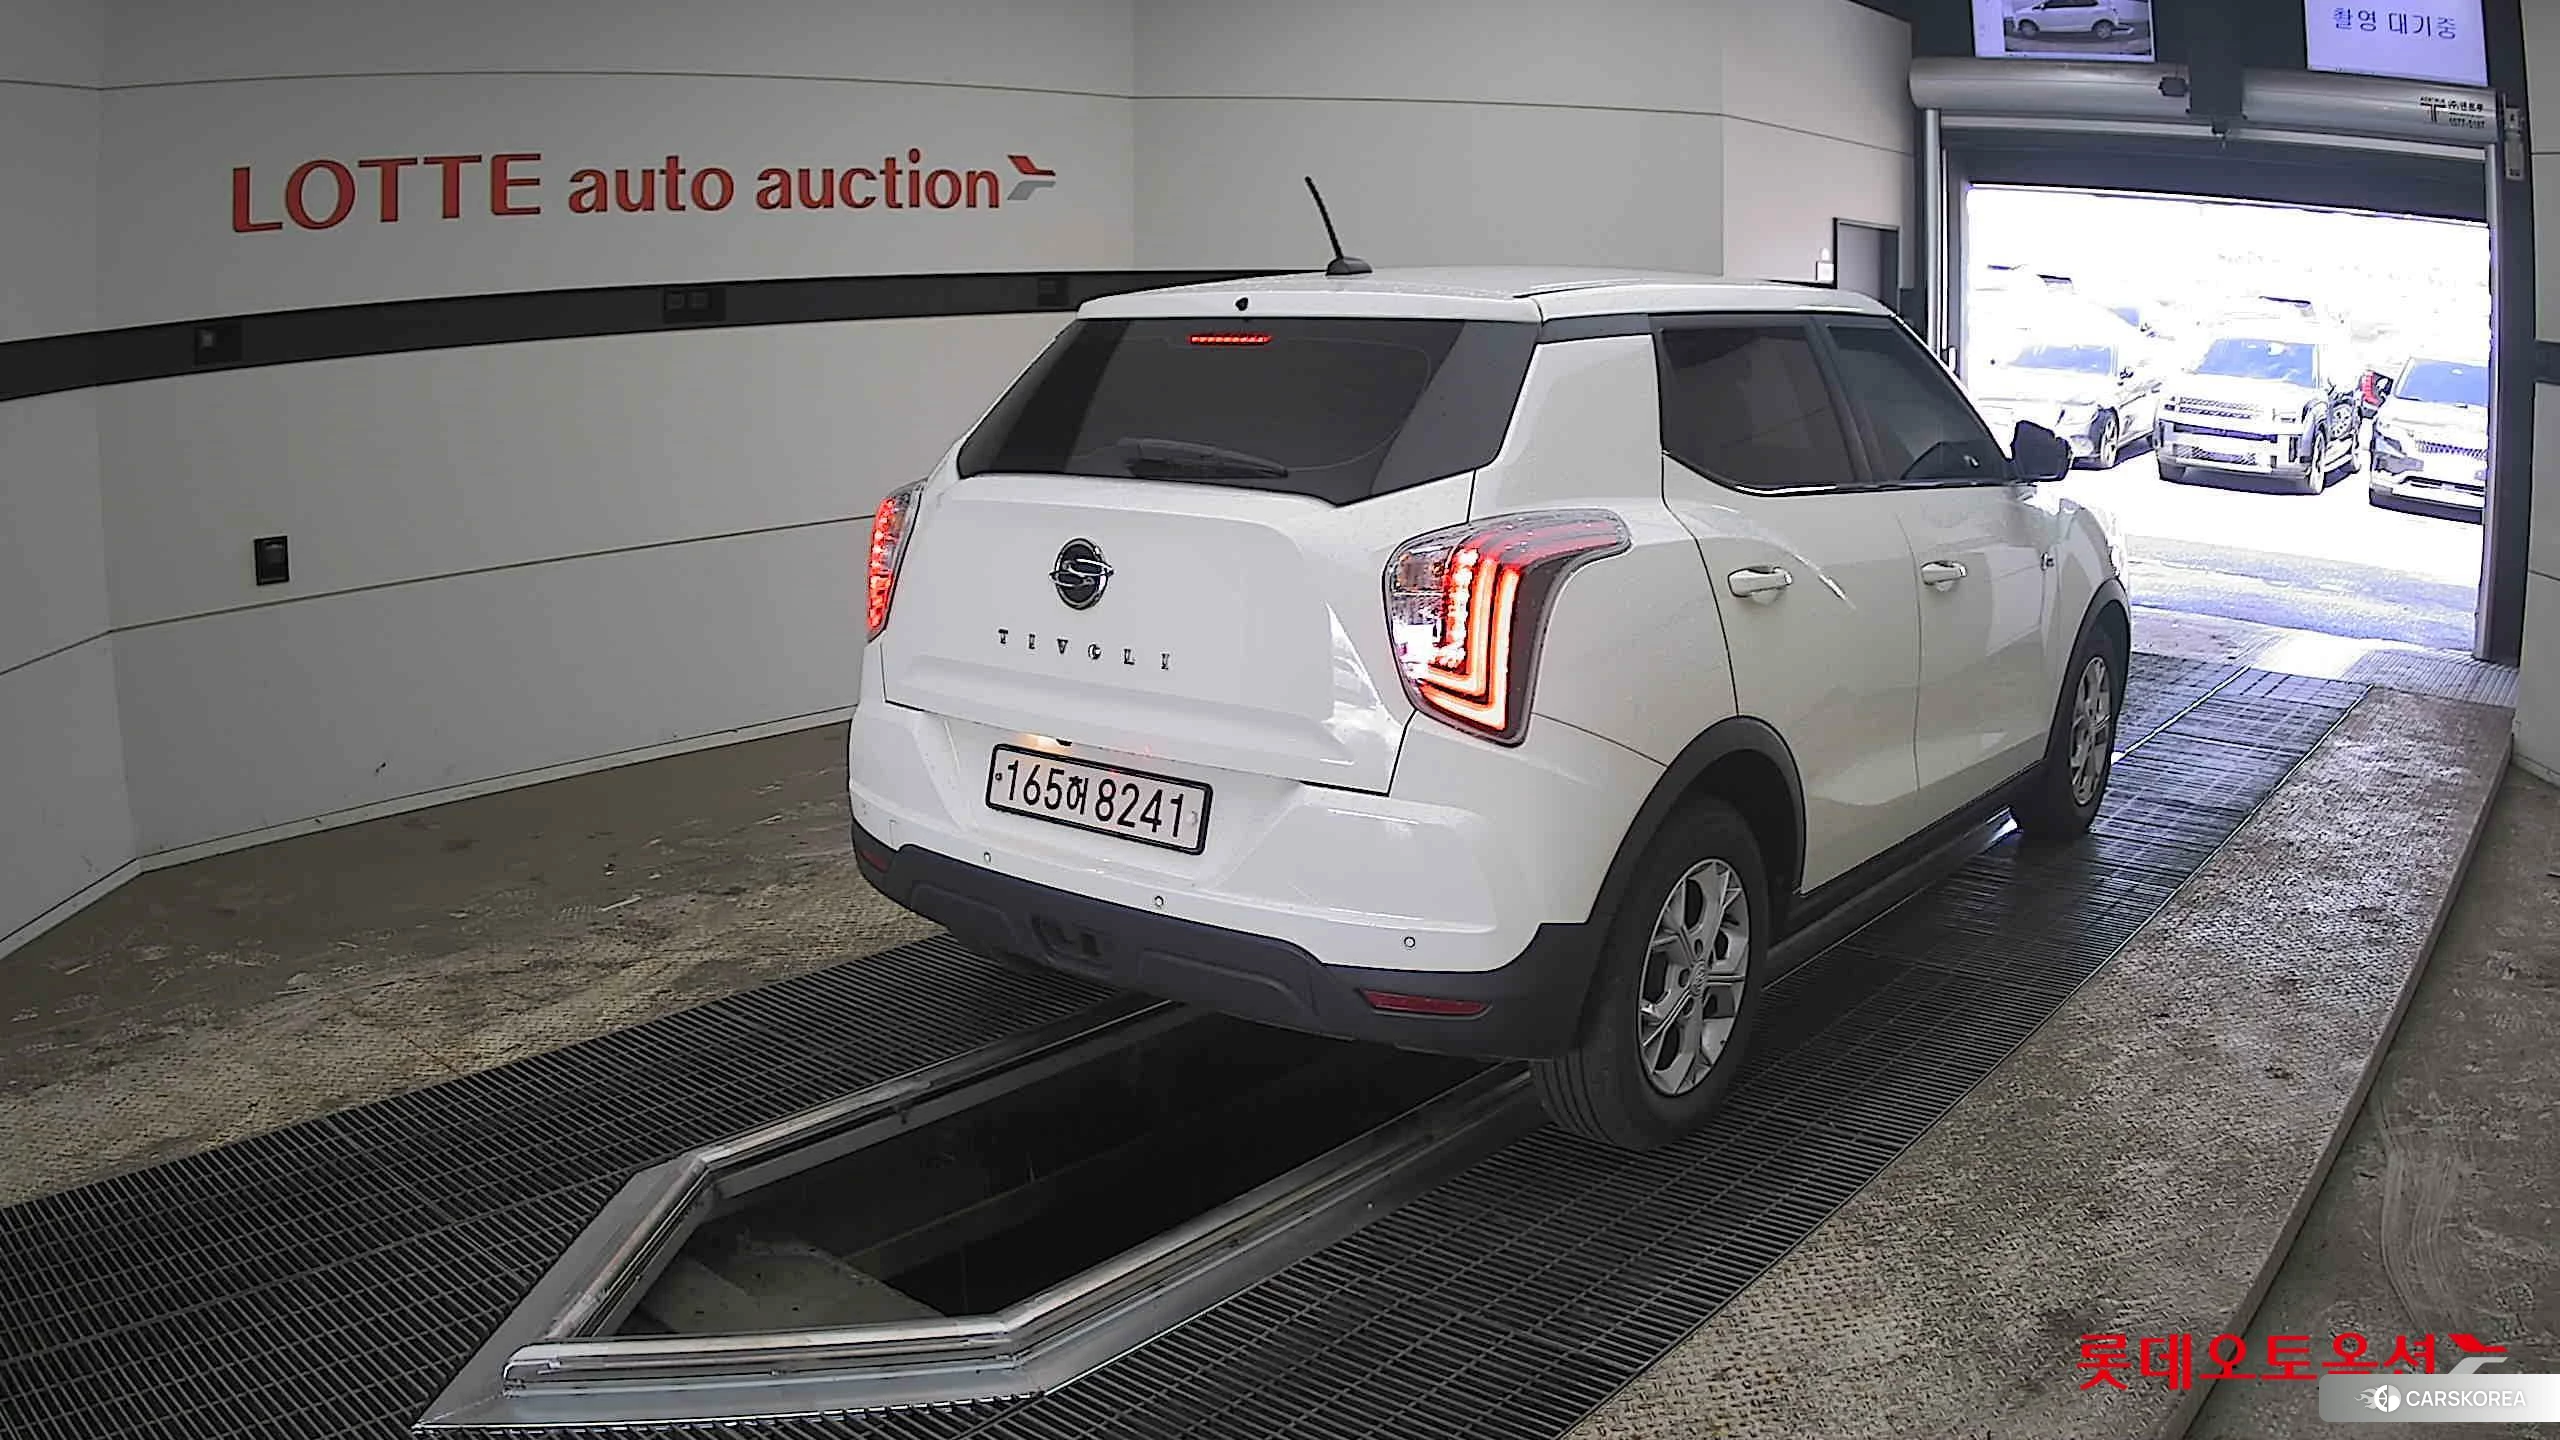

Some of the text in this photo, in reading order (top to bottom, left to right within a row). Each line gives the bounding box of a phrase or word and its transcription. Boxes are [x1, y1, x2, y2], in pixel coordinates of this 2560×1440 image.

[2388, 12, 2456, 40] 대기중
[232, 148, 1001, 232] LOTTE auto auction
[998, 628, 1171, 671] TIVOLI
[1094, 778, 1185, 838] 8241
